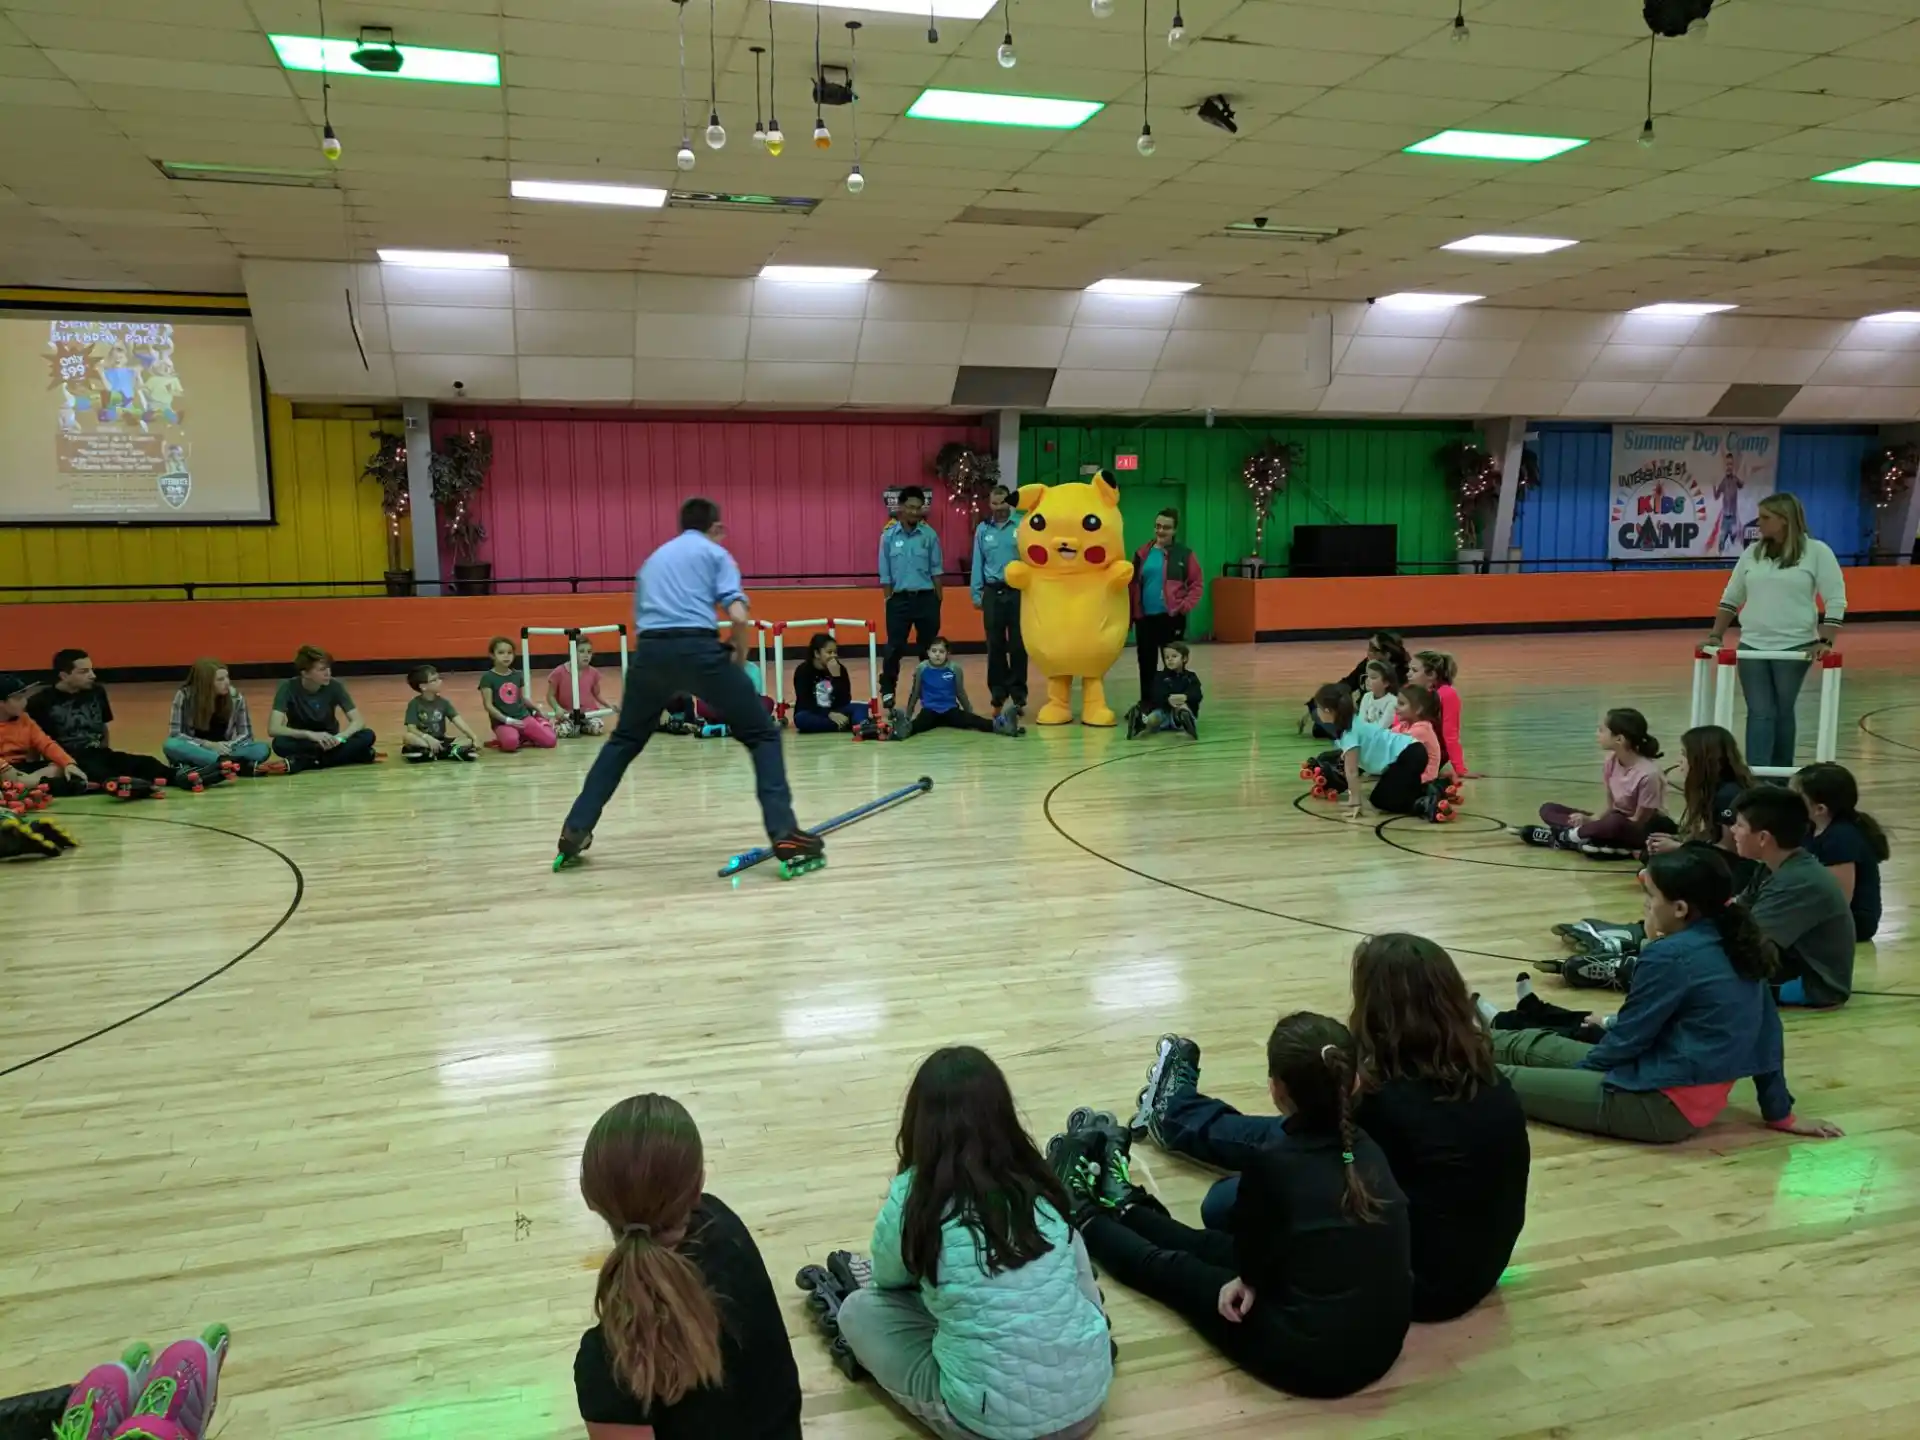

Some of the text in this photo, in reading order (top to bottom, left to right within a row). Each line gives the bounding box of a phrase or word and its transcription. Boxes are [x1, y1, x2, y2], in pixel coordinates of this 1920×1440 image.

[59, 354, 83, 366] Only
[60, 364, 85, 379] $99
[1624, 430, 1770, 457] Summer Day Camp
[1637, 495, 1687, 516] KIDS
[1618, 515, 1699, 550] CAMP
